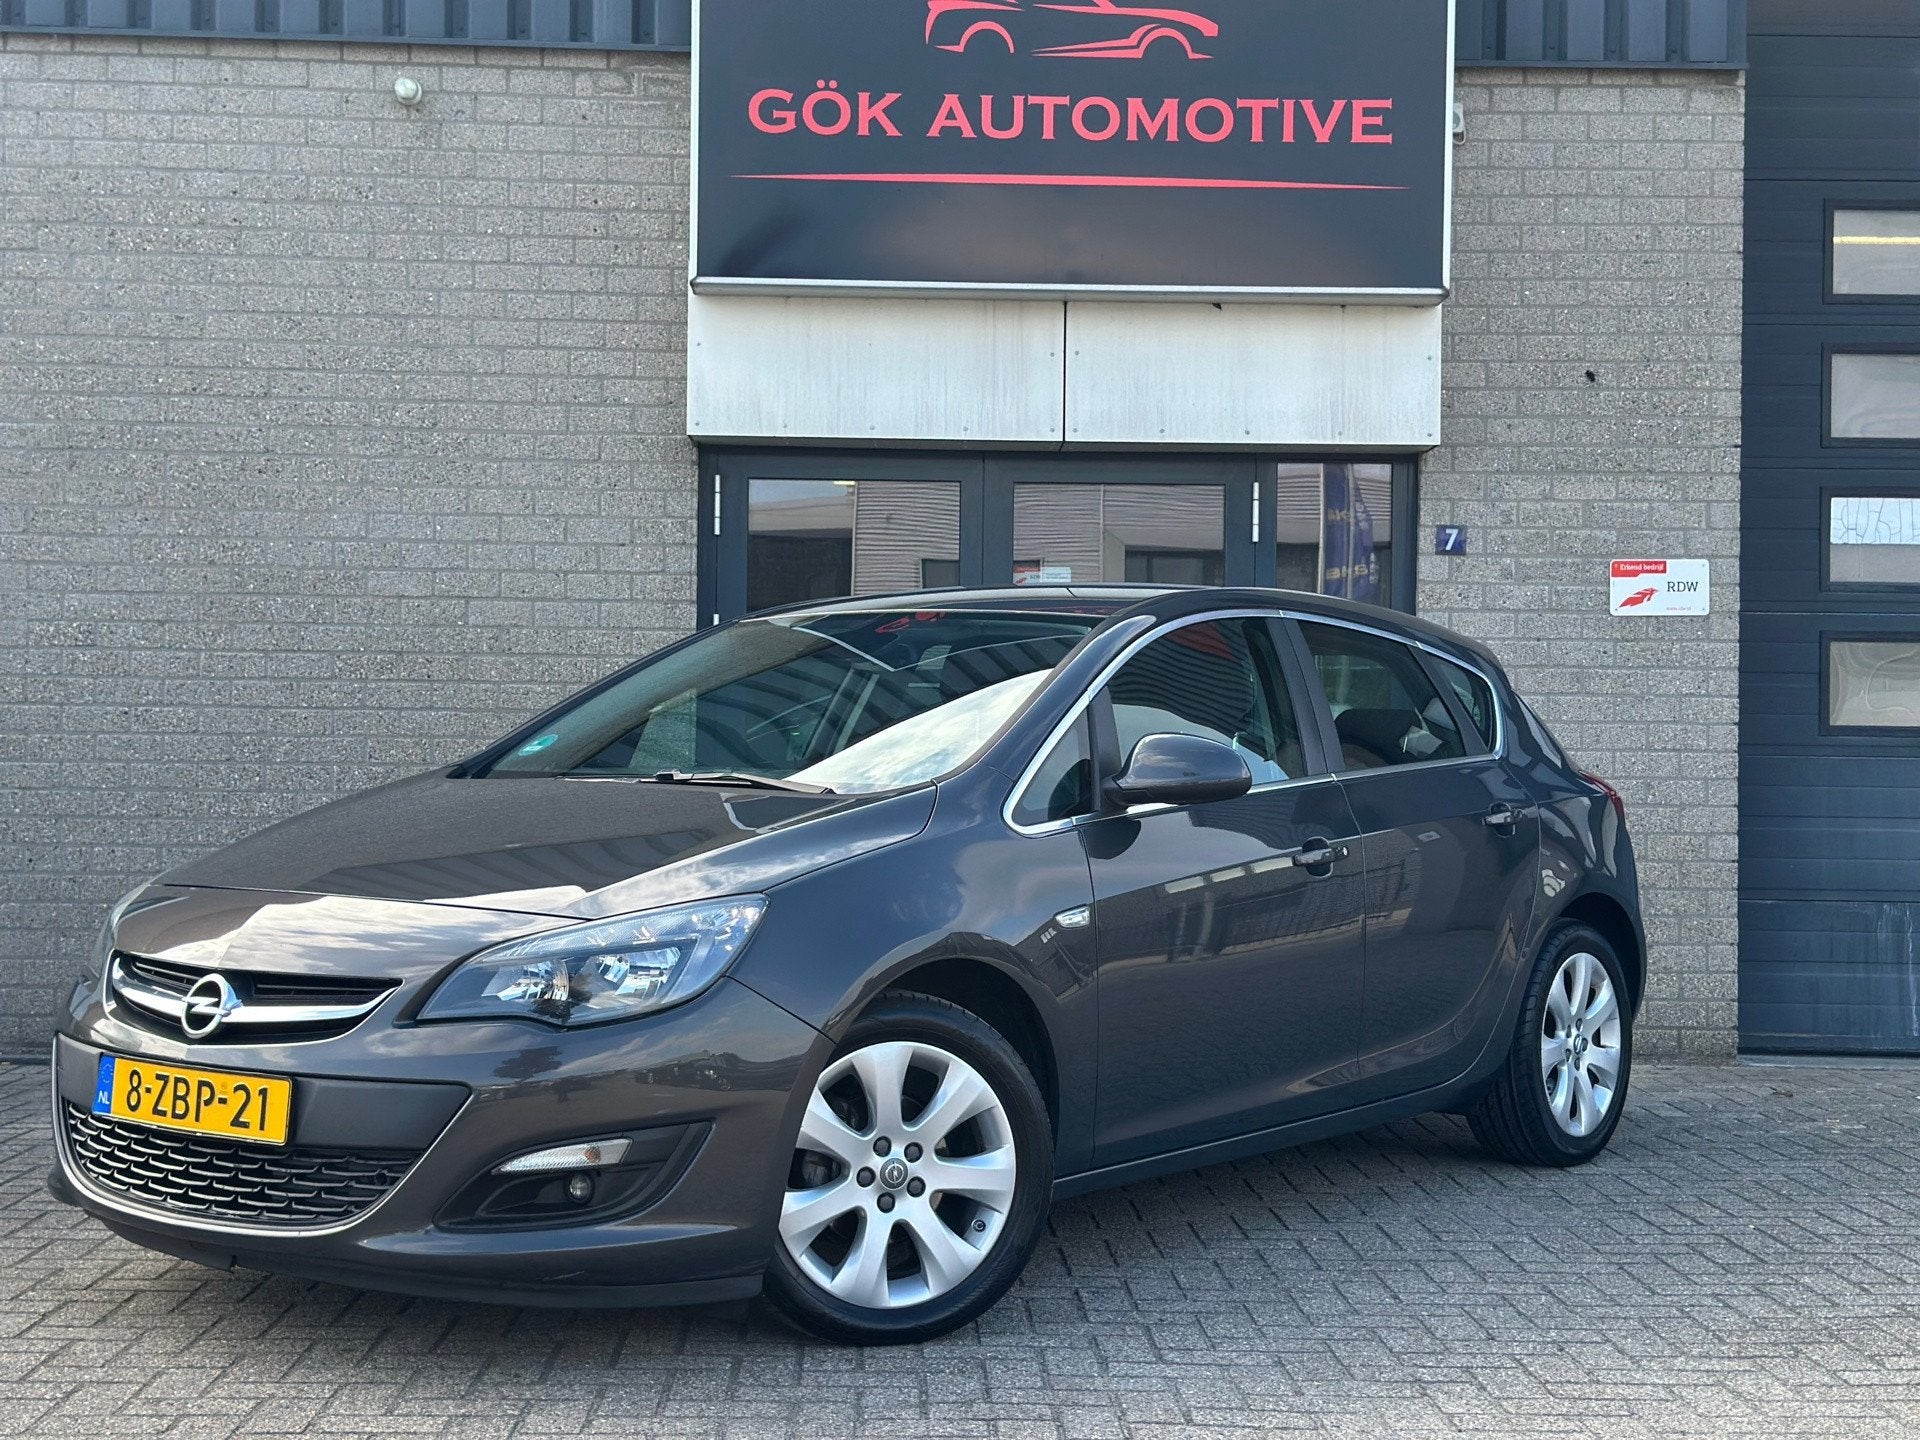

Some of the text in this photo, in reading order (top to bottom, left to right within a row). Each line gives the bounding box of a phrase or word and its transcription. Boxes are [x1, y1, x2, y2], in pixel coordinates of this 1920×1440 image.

[748, 80, 1393, 145] GÖK AUTOMOTIVE
[1445, 528, 1459, 551] 7
[1667, 581, 1699, 592] RDW
[97, 1090, 110, 1104] NL
[126, 1069, 268, 1131] 8-ZBP-21
